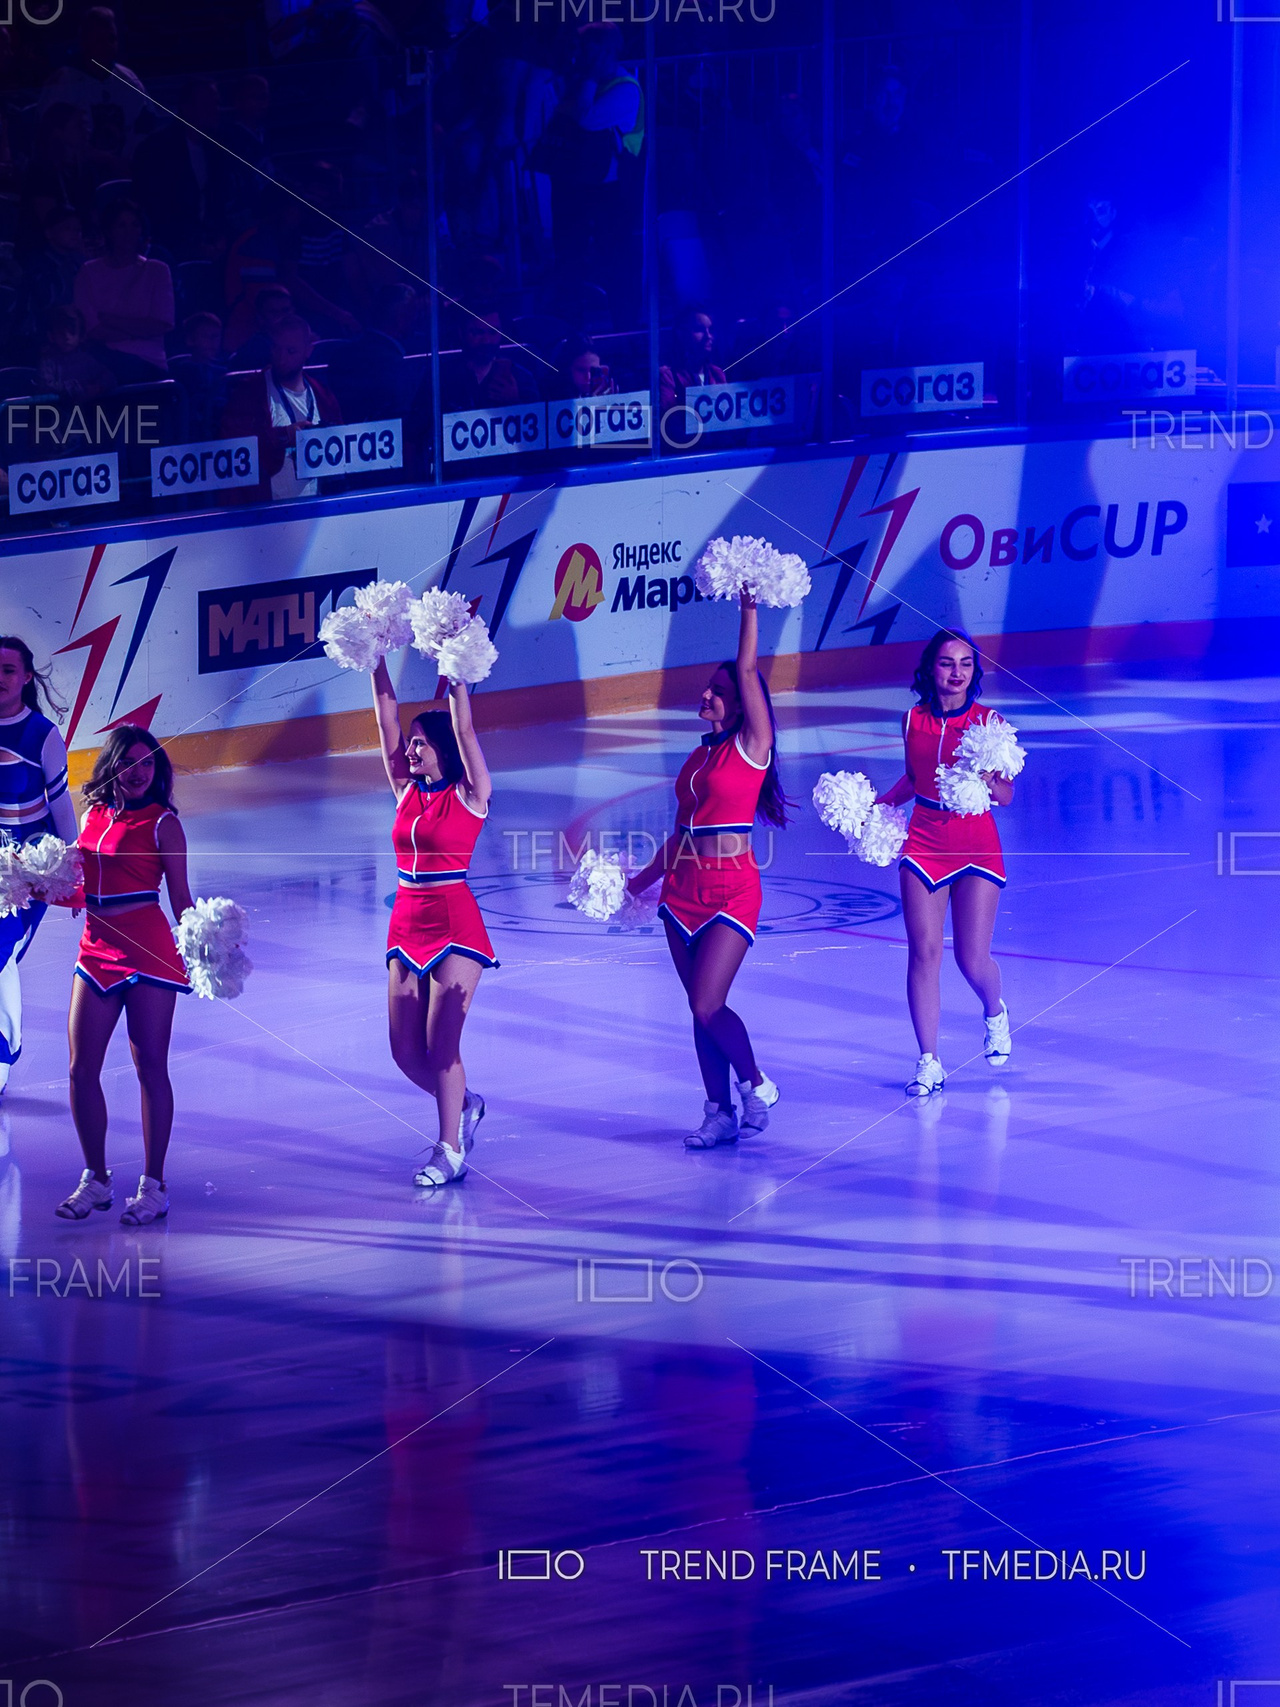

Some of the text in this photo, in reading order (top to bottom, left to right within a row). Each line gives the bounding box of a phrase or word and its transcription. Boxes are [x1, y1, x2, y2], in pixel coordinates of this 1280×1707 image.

[612, 540, 682, 571] Яндекс
[610, 575, 728, 613] Мар
[208, 591, 315, 657] МАТЧ
